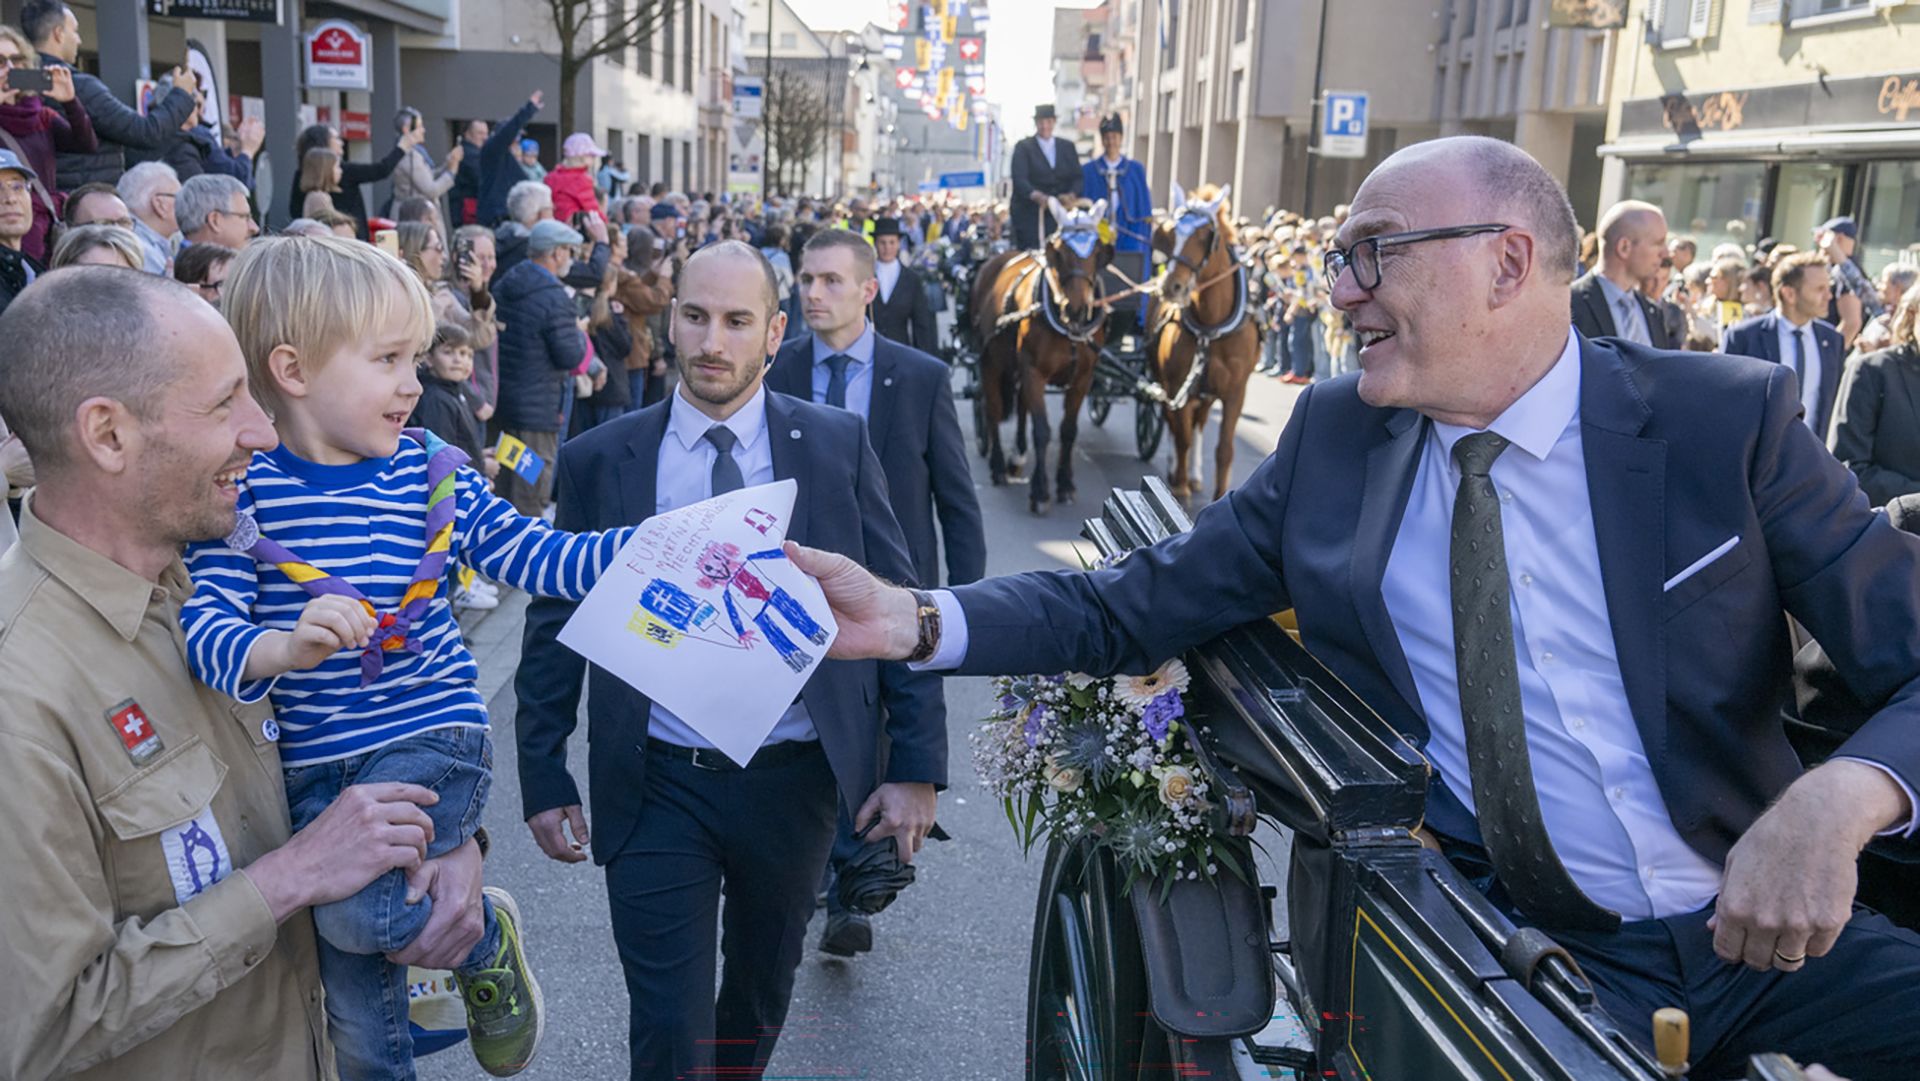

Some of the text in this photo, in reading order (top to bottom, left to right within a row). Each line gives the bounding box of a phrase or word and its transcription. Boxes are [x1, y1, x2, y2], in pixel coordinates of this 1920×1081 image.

[1332, 98, 1354, 131] P
[655, 526, 688, 572] MARTIN
[664, 530, 702, 574] HECHT
